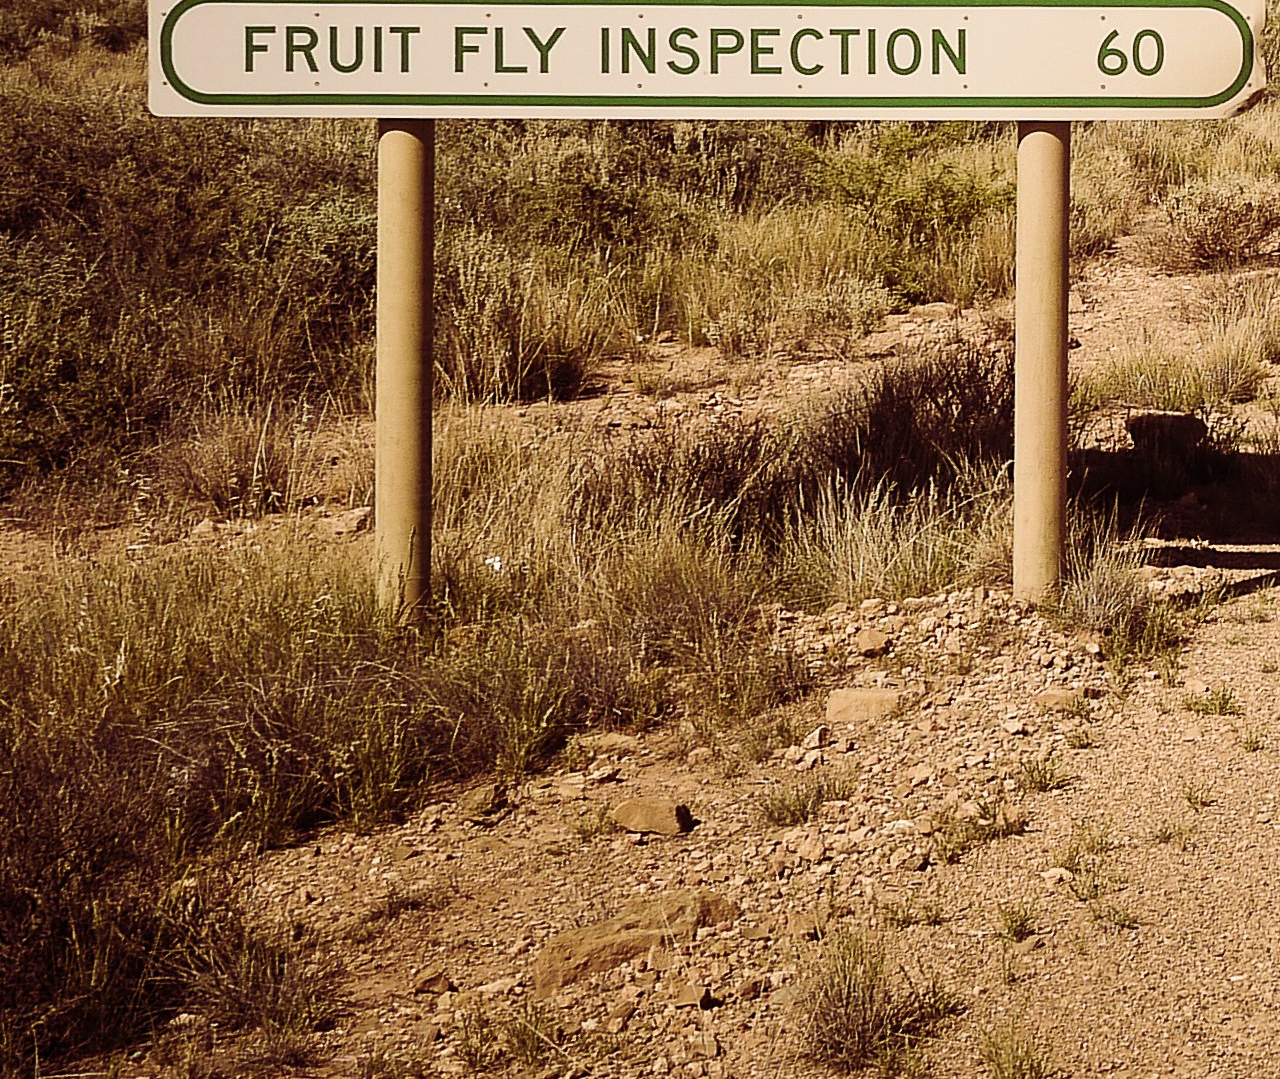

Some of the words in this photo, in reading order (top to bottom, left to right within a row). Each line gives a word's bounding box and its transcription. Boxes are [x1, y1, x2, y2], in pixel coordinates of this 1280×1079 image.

[244, 25, 421, 74] FRUIT
[454, 26, 565, 74] FLY
[601, 27, 966, 76] INSPECTION
[1097, 29, 1165, 77] 60
